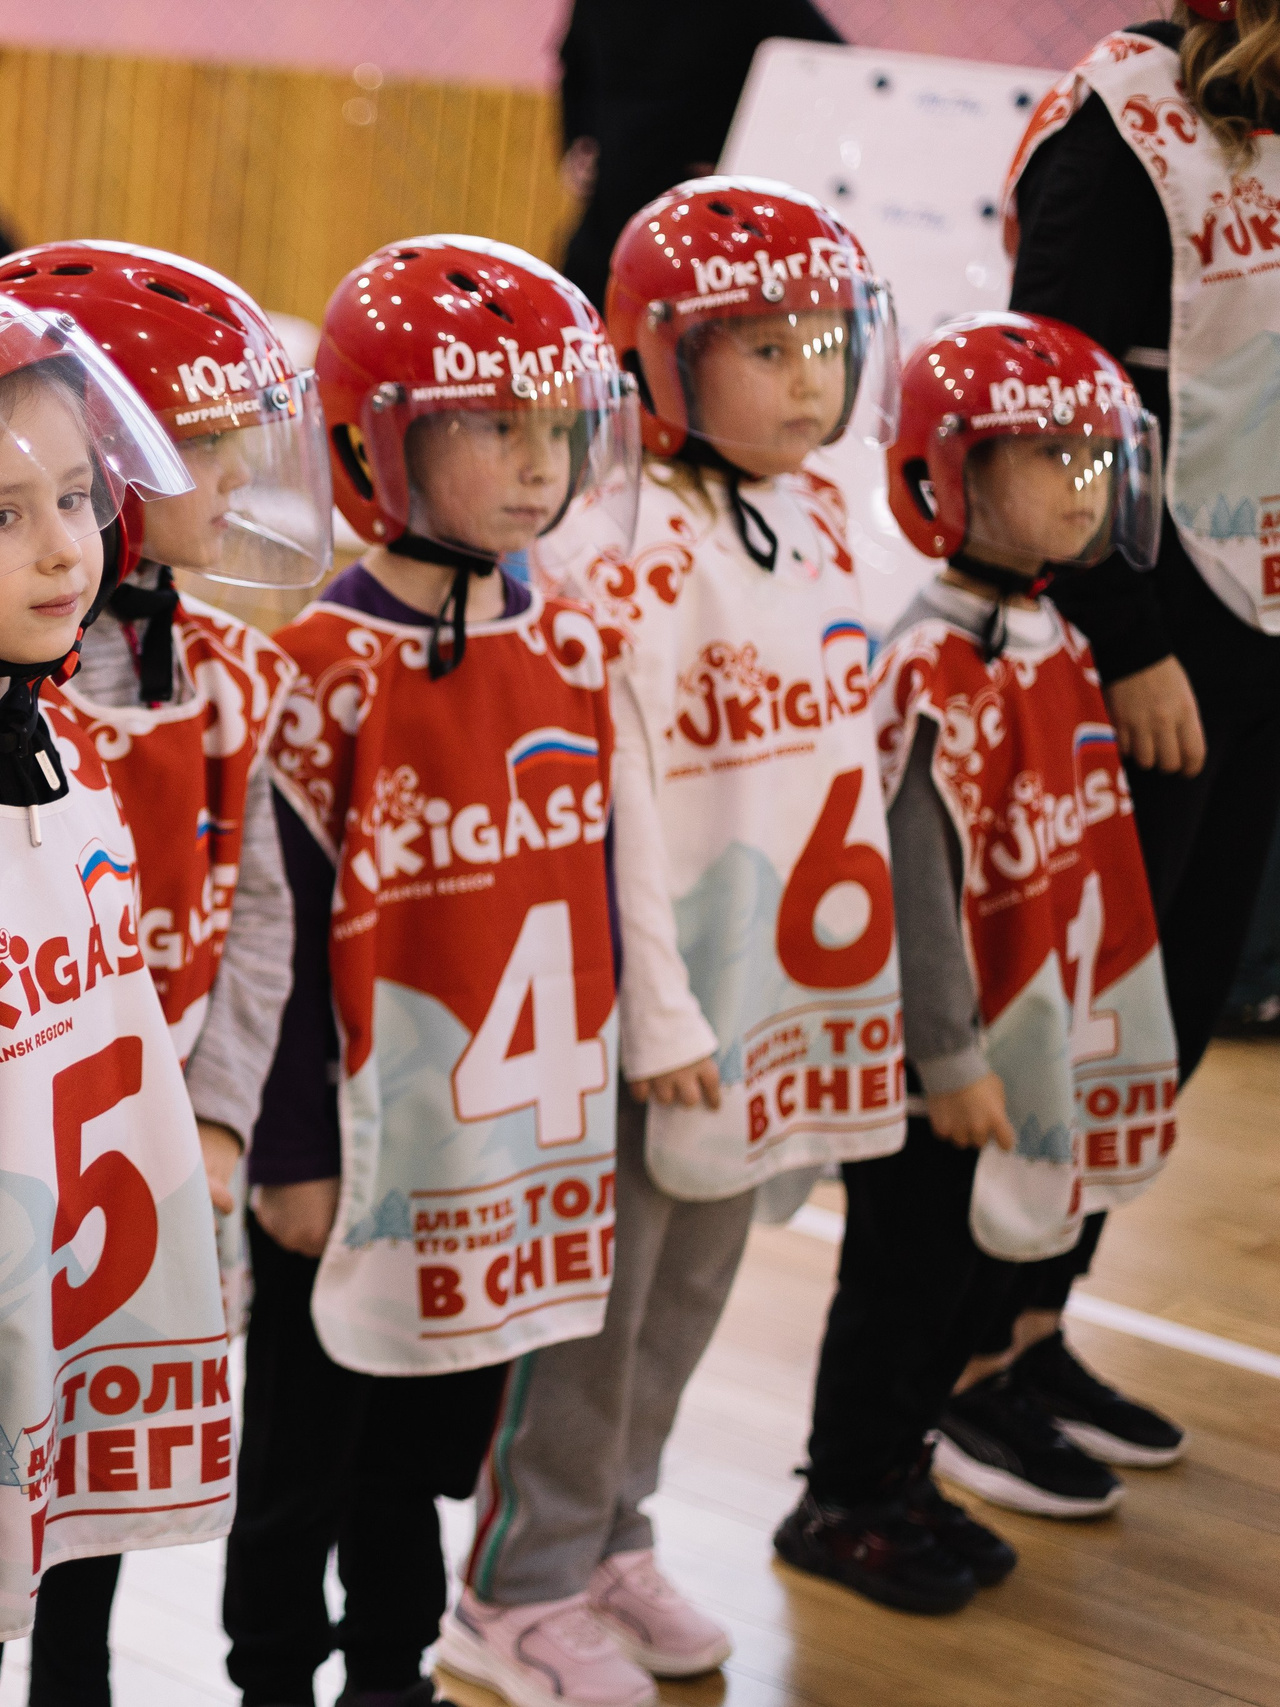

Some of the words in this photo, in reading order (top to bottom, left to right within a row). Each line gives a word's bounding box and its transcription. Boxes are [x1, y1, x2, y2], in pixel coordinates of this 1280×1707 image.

[175, 399, 261, 426] МУРМАНСК
[775, 766, 895, 990] 6
[35, 1016, 74, 1049] REGION
[450, 899, 608, 1150] 4
[51, 1035, 159, 1352] 5
[419, 1264, 466, 1320] В
[61, 1354, 232, 1423] ТОЛК
